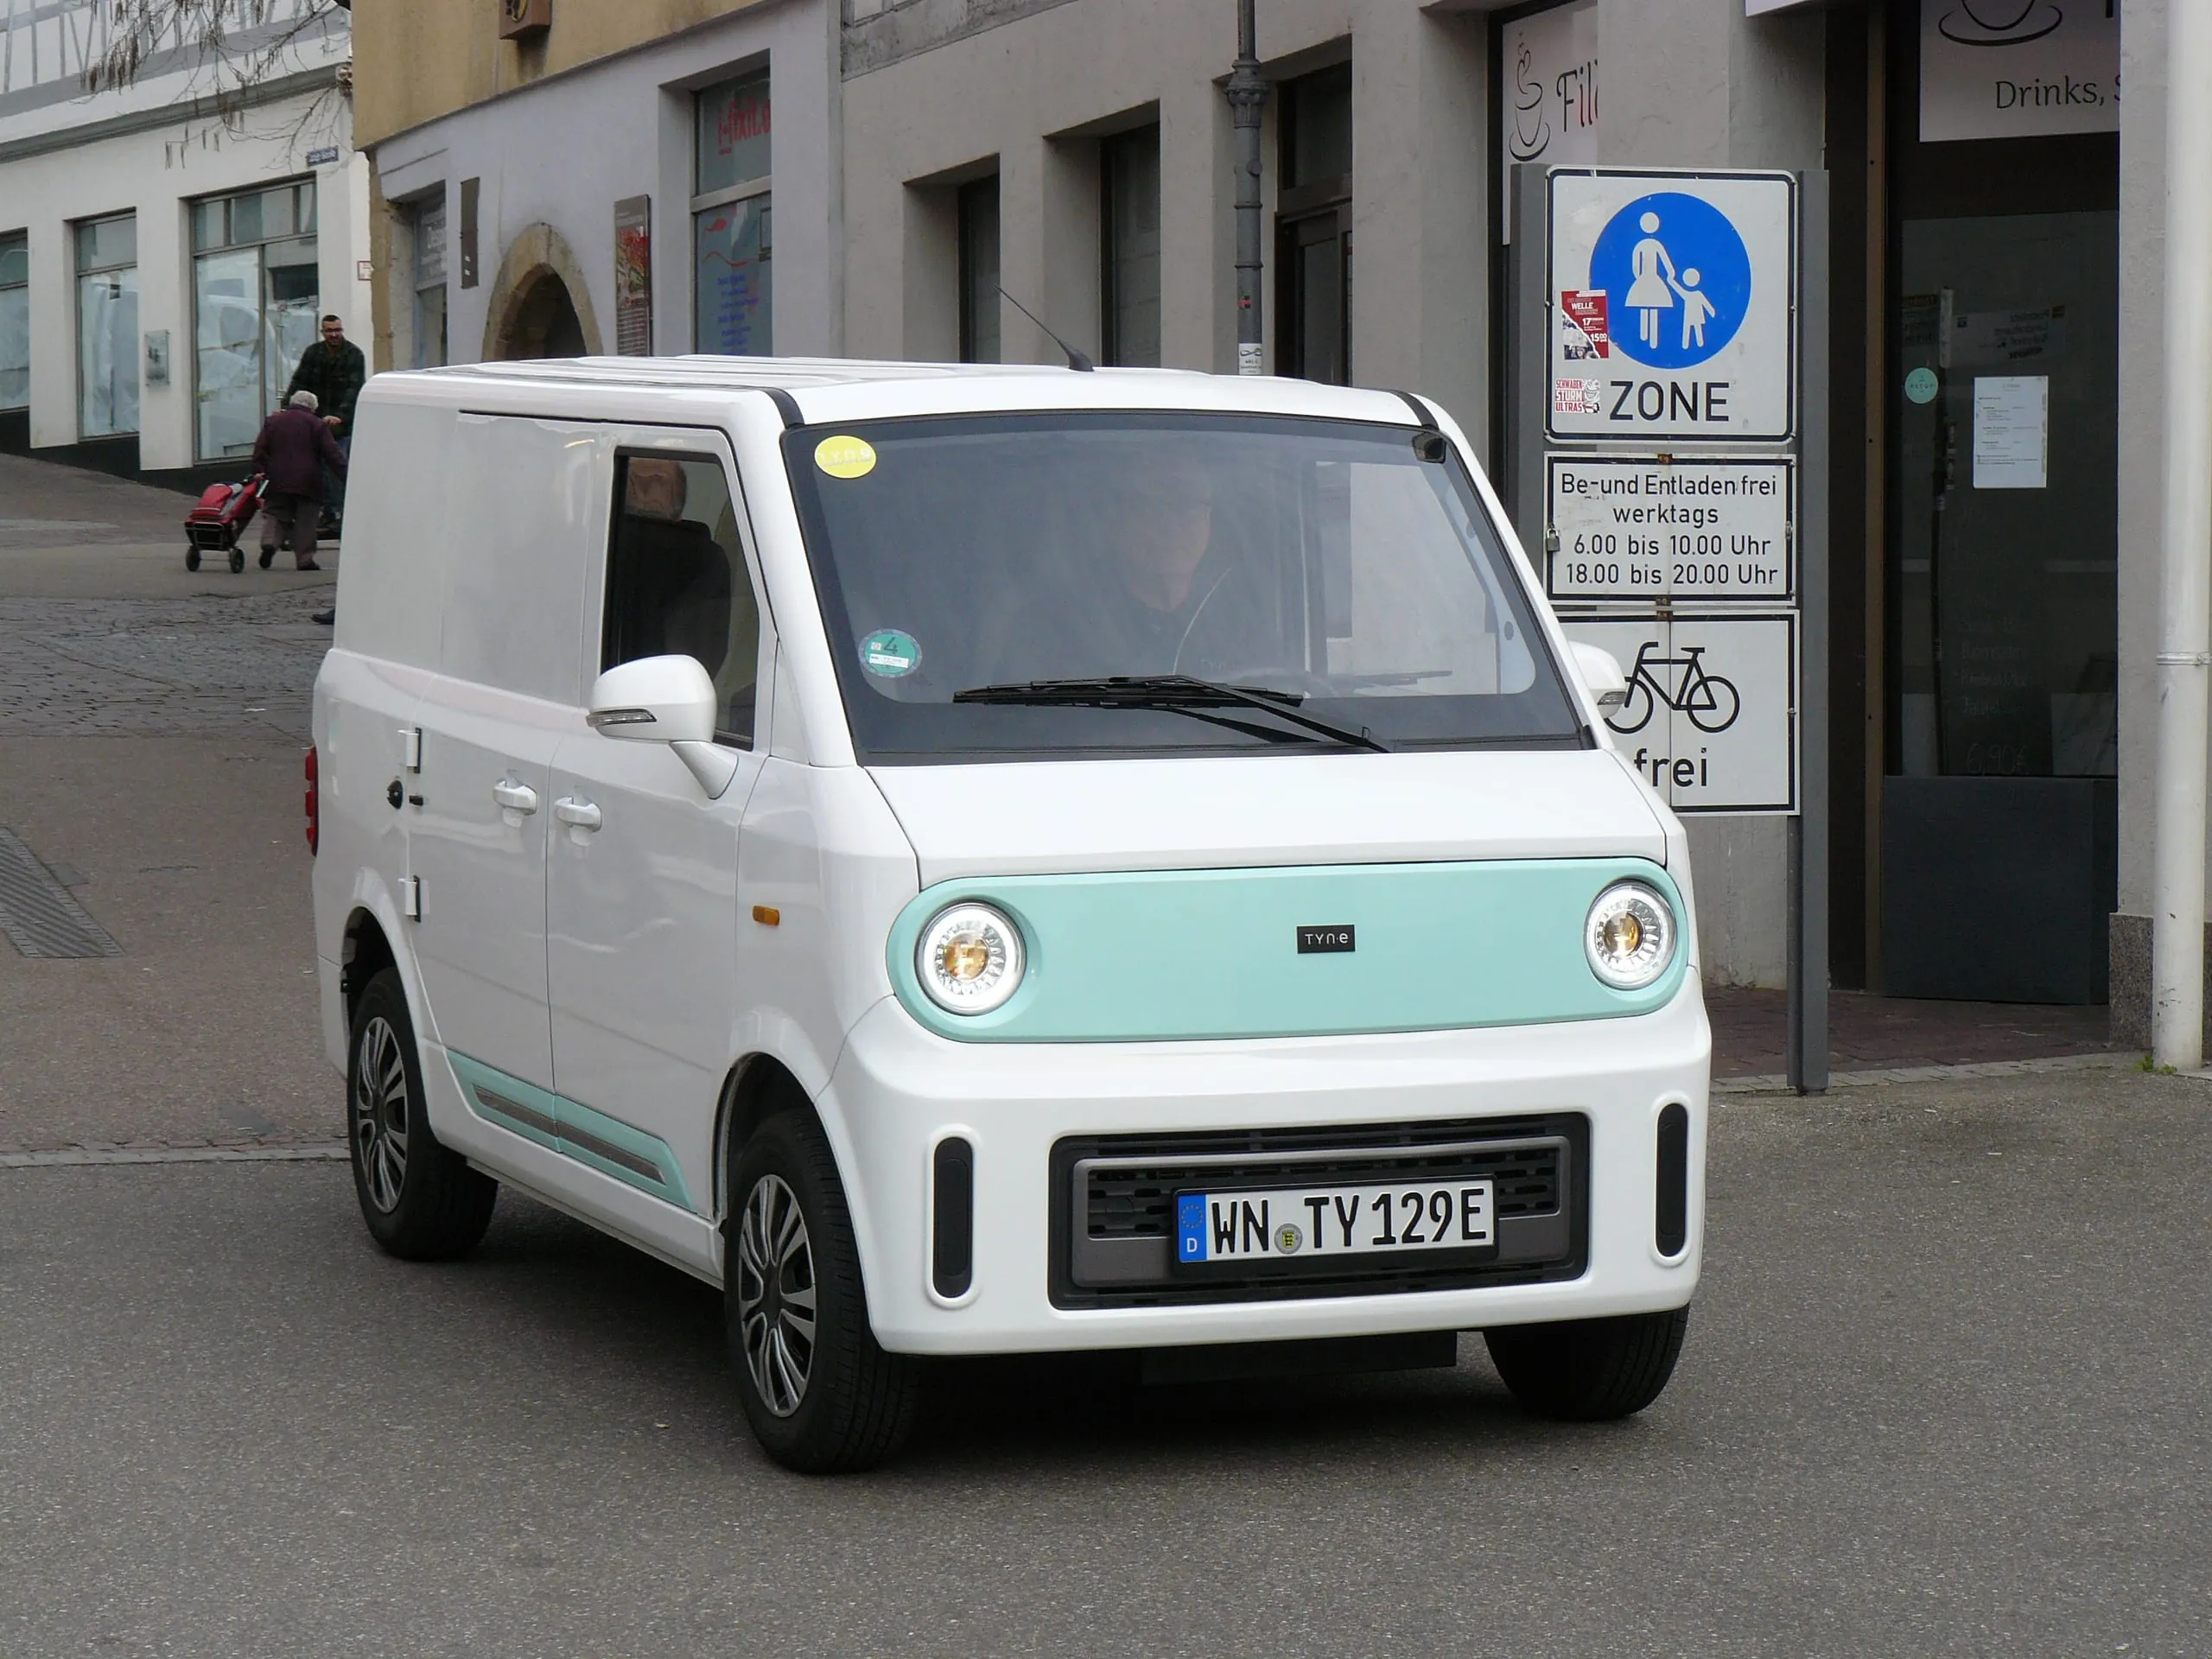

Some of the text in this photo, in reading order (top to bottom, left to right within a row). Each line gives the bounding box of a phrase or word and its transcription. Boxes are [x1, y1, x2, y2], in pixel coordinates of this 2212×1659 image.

[1994, 75, 2105, 109] Drinks,
[1555, 391, 1583, 402] STURM
[1609, 380, 1729, 422] ZONE
[1555, 403, 1583, 412] ULTRAS
[1645, 474, 1736, 495] Entladen
[1740, 474, 1777, 495] frei
[1613, 505, 1719, 529] werktags
[1573, 534, 1771, 555] 6.00 bis 10.00 Uhr
[1566, 563, 1778, 584] 18.00 bis 20.00 Uhr
[1634, 747, 1708, 787] frei
[1211, 1198, 1269, 1254] WN
[1186, 1237, 1198, 1253] D
